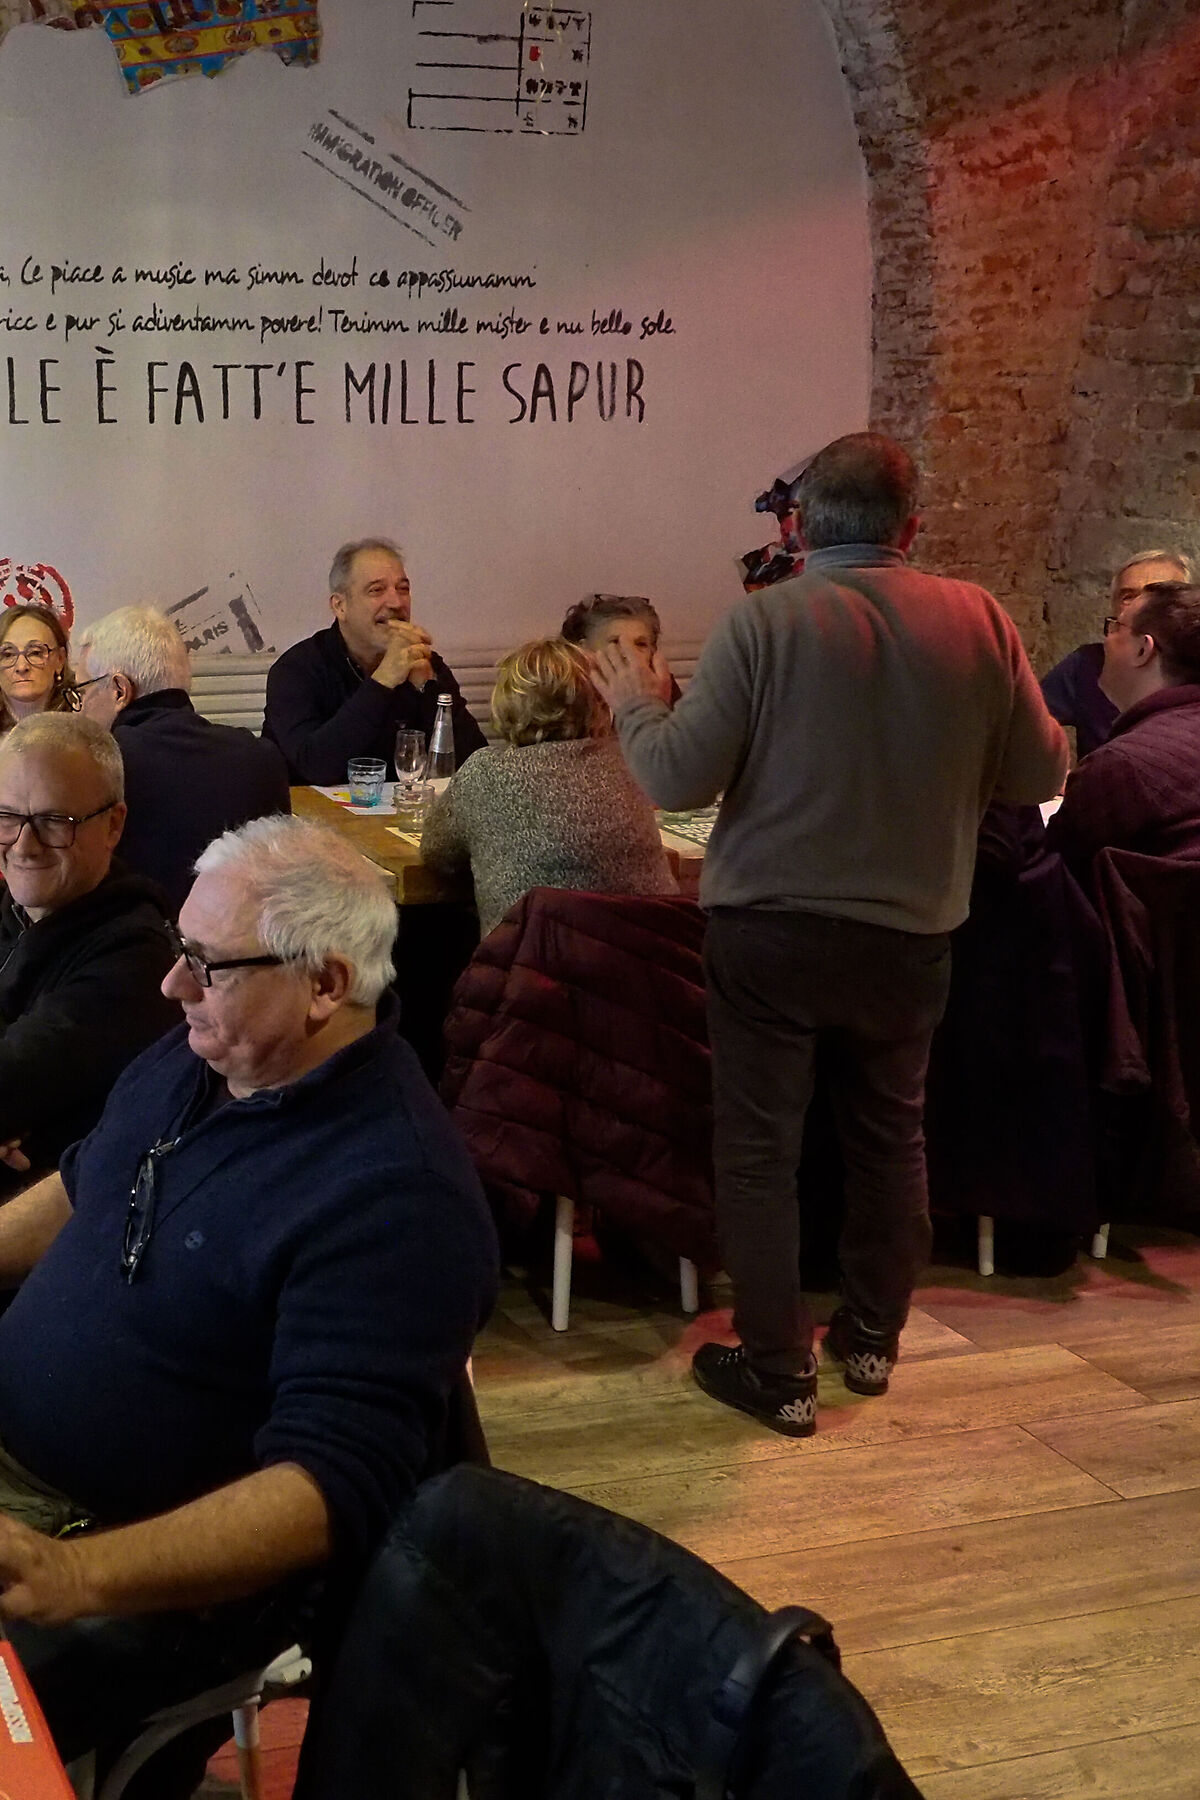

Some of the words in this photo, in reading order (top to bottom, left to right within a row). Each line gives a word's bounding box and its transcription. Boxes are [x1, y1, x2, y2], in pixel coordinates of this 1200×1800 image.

[50, 259, 105, 296] piace
[111, 266, 128, 285] a
[134, 260, 197, 290] music
[204, 267, 242, 287] ma
[311, 255, 359, 288] devot
[45, 312, 58, 332] e
[64, 314, 101, 343] pur
[106, 307, 127, 338] si
[131, 301, 256, 333] adiventamm
[259, 304, 323, 345] povere!
[327, 309, 411, 334] Tenimm
[417, 307, 470, 335] mille
[475, 305, 533, 340] mister
[539, 316, 551, 336] e
[556, 321, 585, 335] nu
[590, 308, 633, 337] bello
[94, 345, 118, 425] È
[147, 359, 317, 426] FATT'E
[344, 358, 477, 426] MILLE
[501, 357, 646, 425] SAPUR
